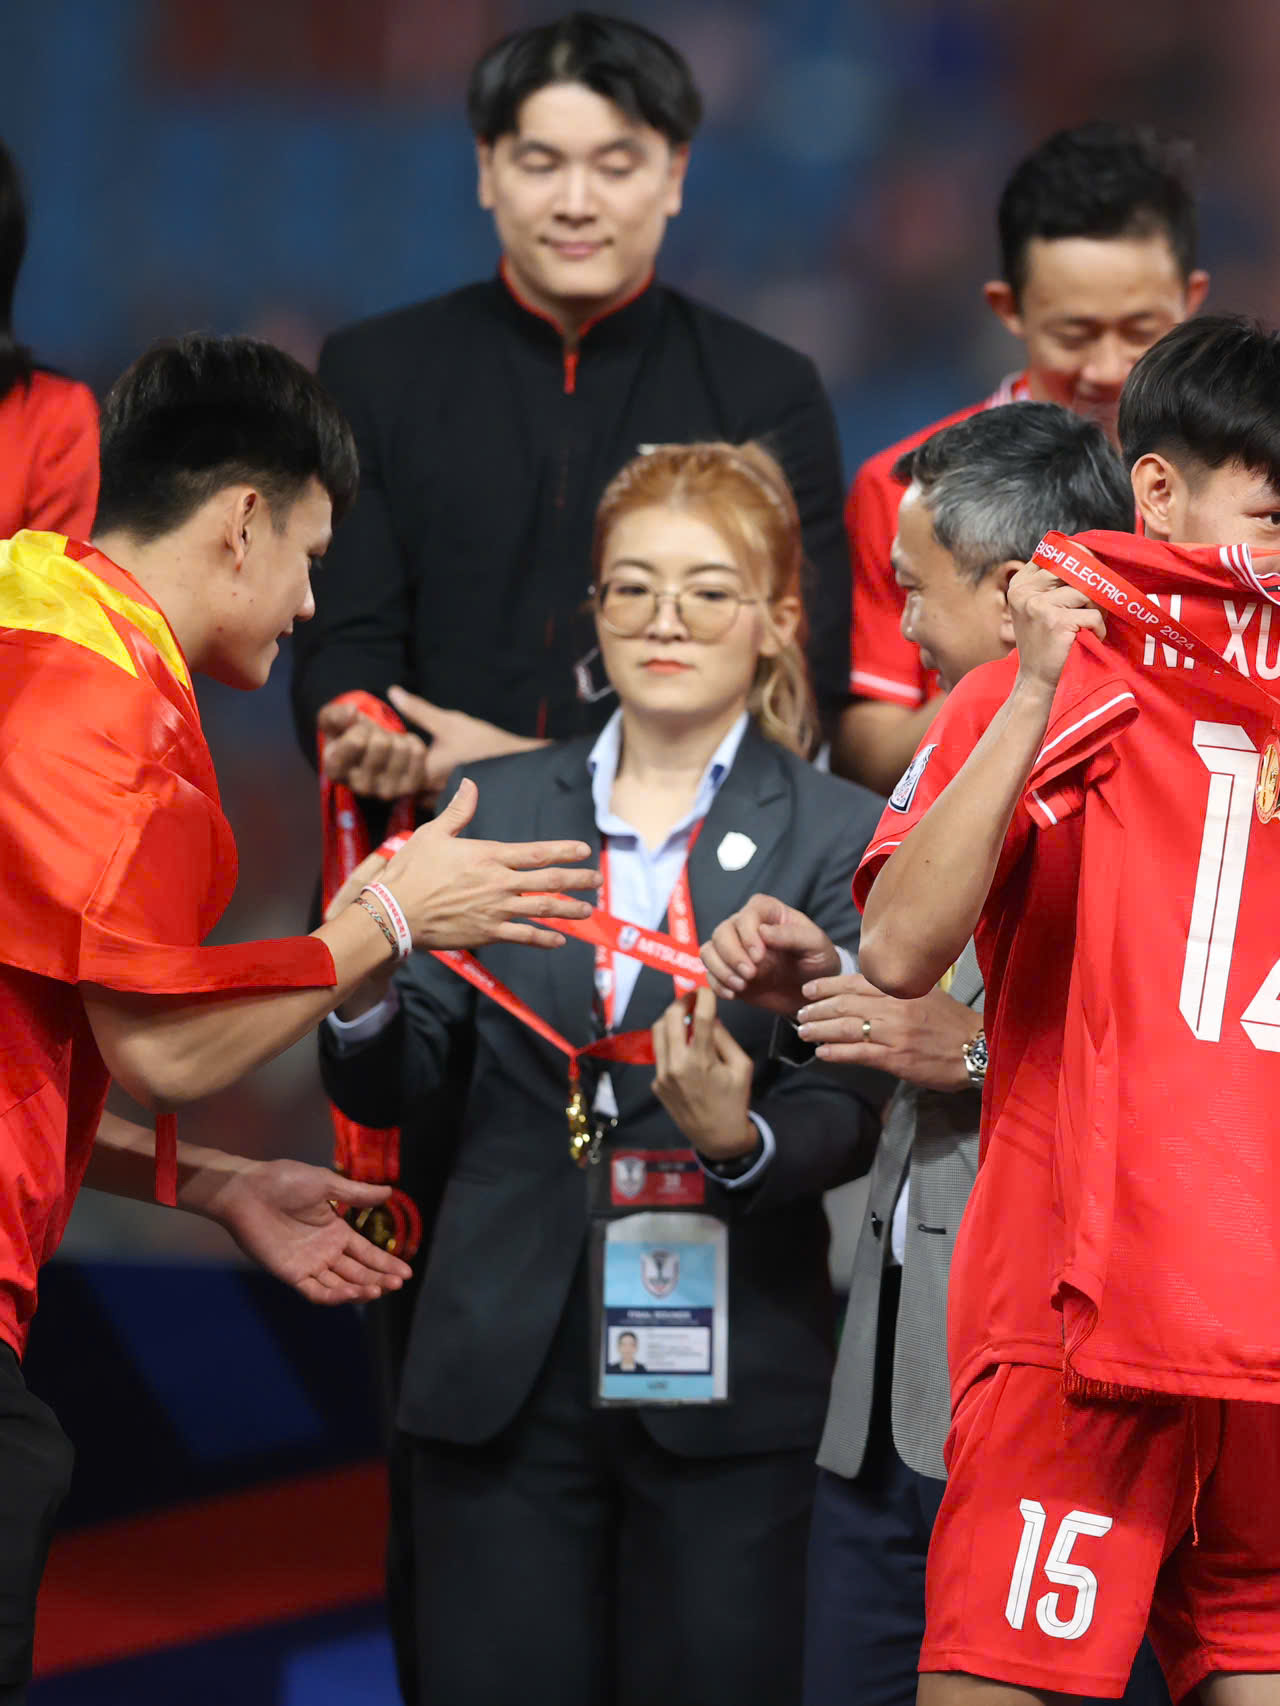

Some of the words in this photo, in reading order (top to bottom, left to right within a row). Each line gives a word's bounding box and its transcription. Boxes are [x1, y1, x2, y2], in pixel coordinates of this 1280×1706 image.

[1062, 556, 1128, 605] ELECTRIC
[1127, 601, 1160, 625] CUP
[1160, 625, 1195, 651] 2024
[1005, 1498, 1113, 1640] 15
